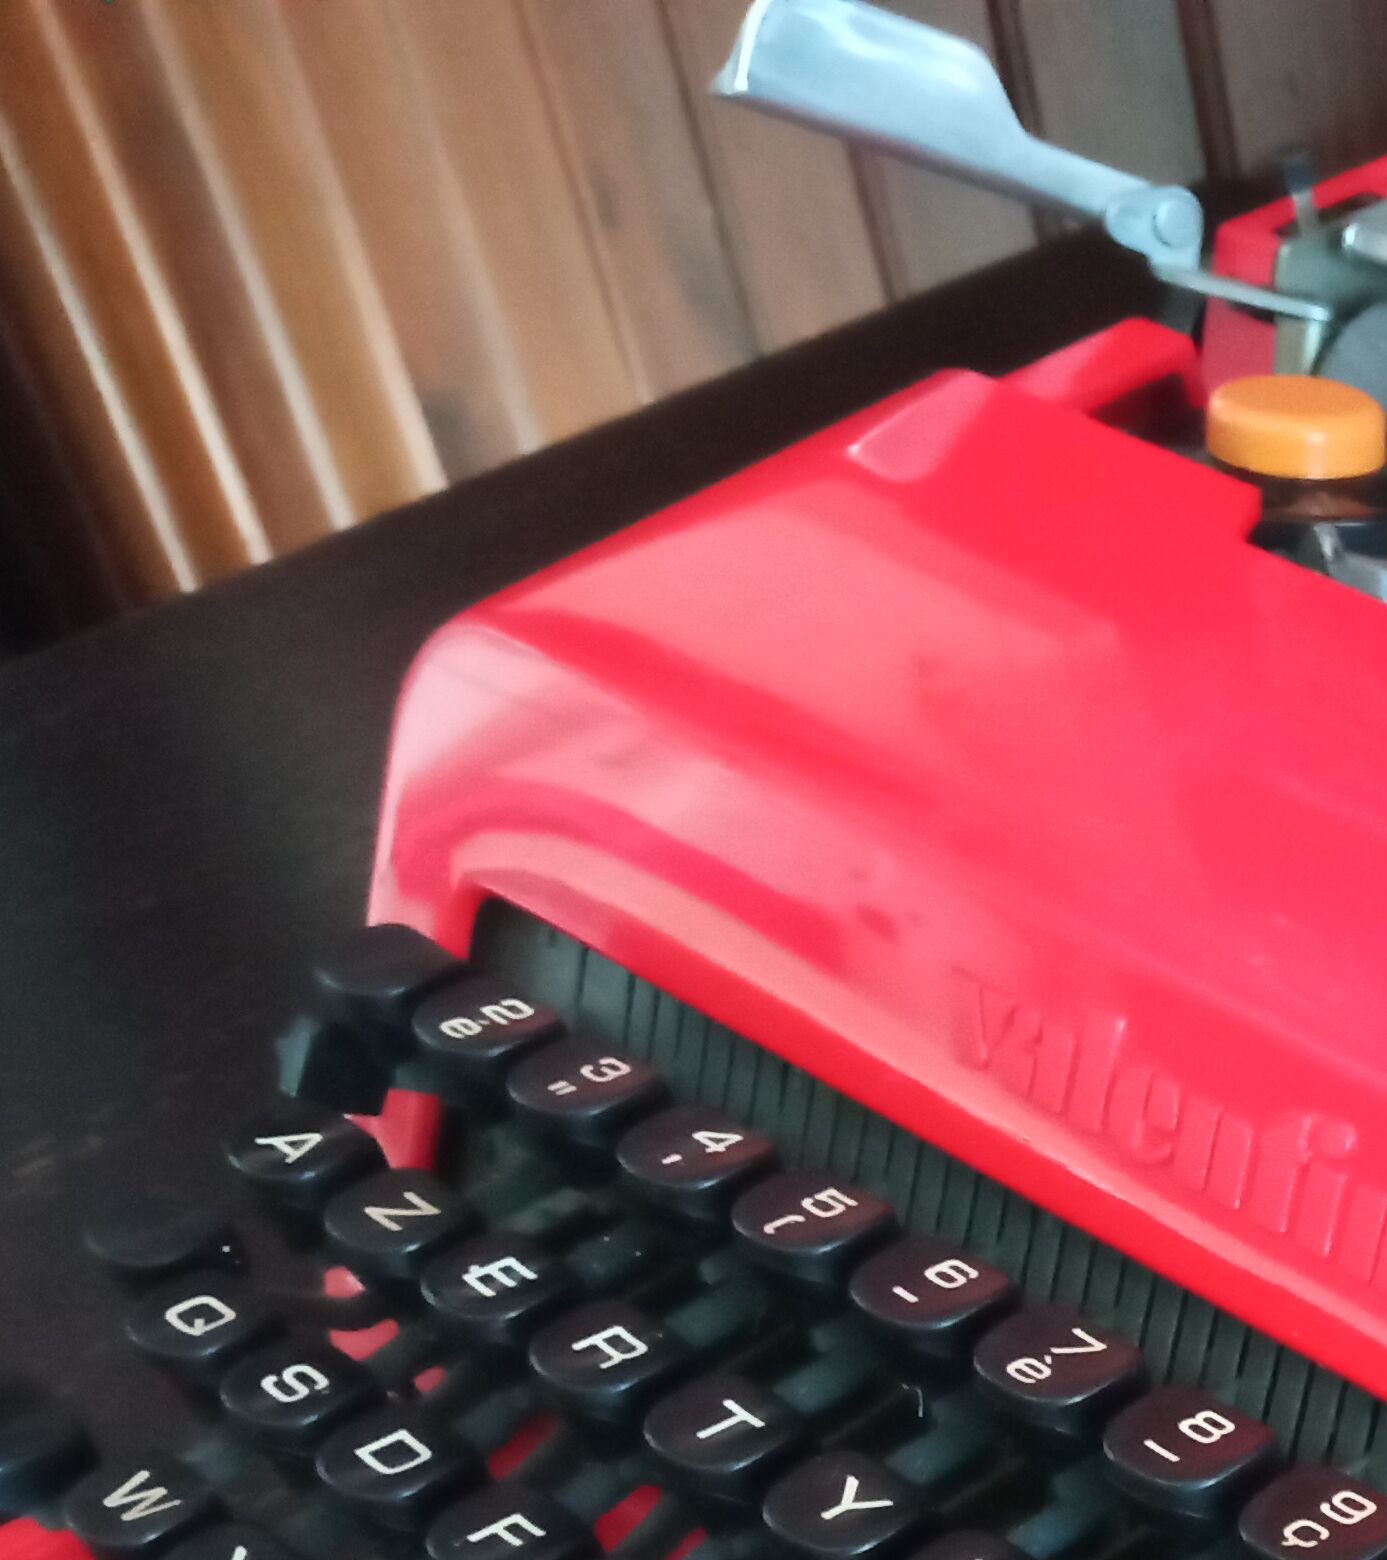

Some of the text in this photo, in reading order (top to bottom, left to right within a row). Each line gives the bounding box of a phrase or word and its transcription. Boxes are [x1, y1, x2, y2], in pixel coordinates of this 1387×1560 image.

[439, 1010, 491, 1039] é
[481, 998, 535, 1025] 2
[579, 1057, 632, 1083] 3
[254, 1132, 324, 1164] A
[691, 1130, 744, 1153] 4
[363, 1191, 441, 1232] Z
[801, 1187, 858, 1218] 5
[461, 1256, 538, 1297] E
[924, 1259, 979, 1289] 6
[164, 1295, 237, 1337] Q
[571, 1325, 648, 1369] R
[1050, 1327, 1108, 1354] 7
[260, 1364, 328, 1403] S
[1006, 1354, 1052, 1384] è
[696, 1399, 766, 1439] T
[1178, 1410, 1236, 1444] 8
[354, 1429, 432, 1475] D
[102, 1470, 182, 1522] W
[820, 1475, 894, 1520] Y
[1319, 1490, 1378, 1525] 9
[466, 1513, 546, 1547] F
[1281, 1519, 1330, 1548] ç
